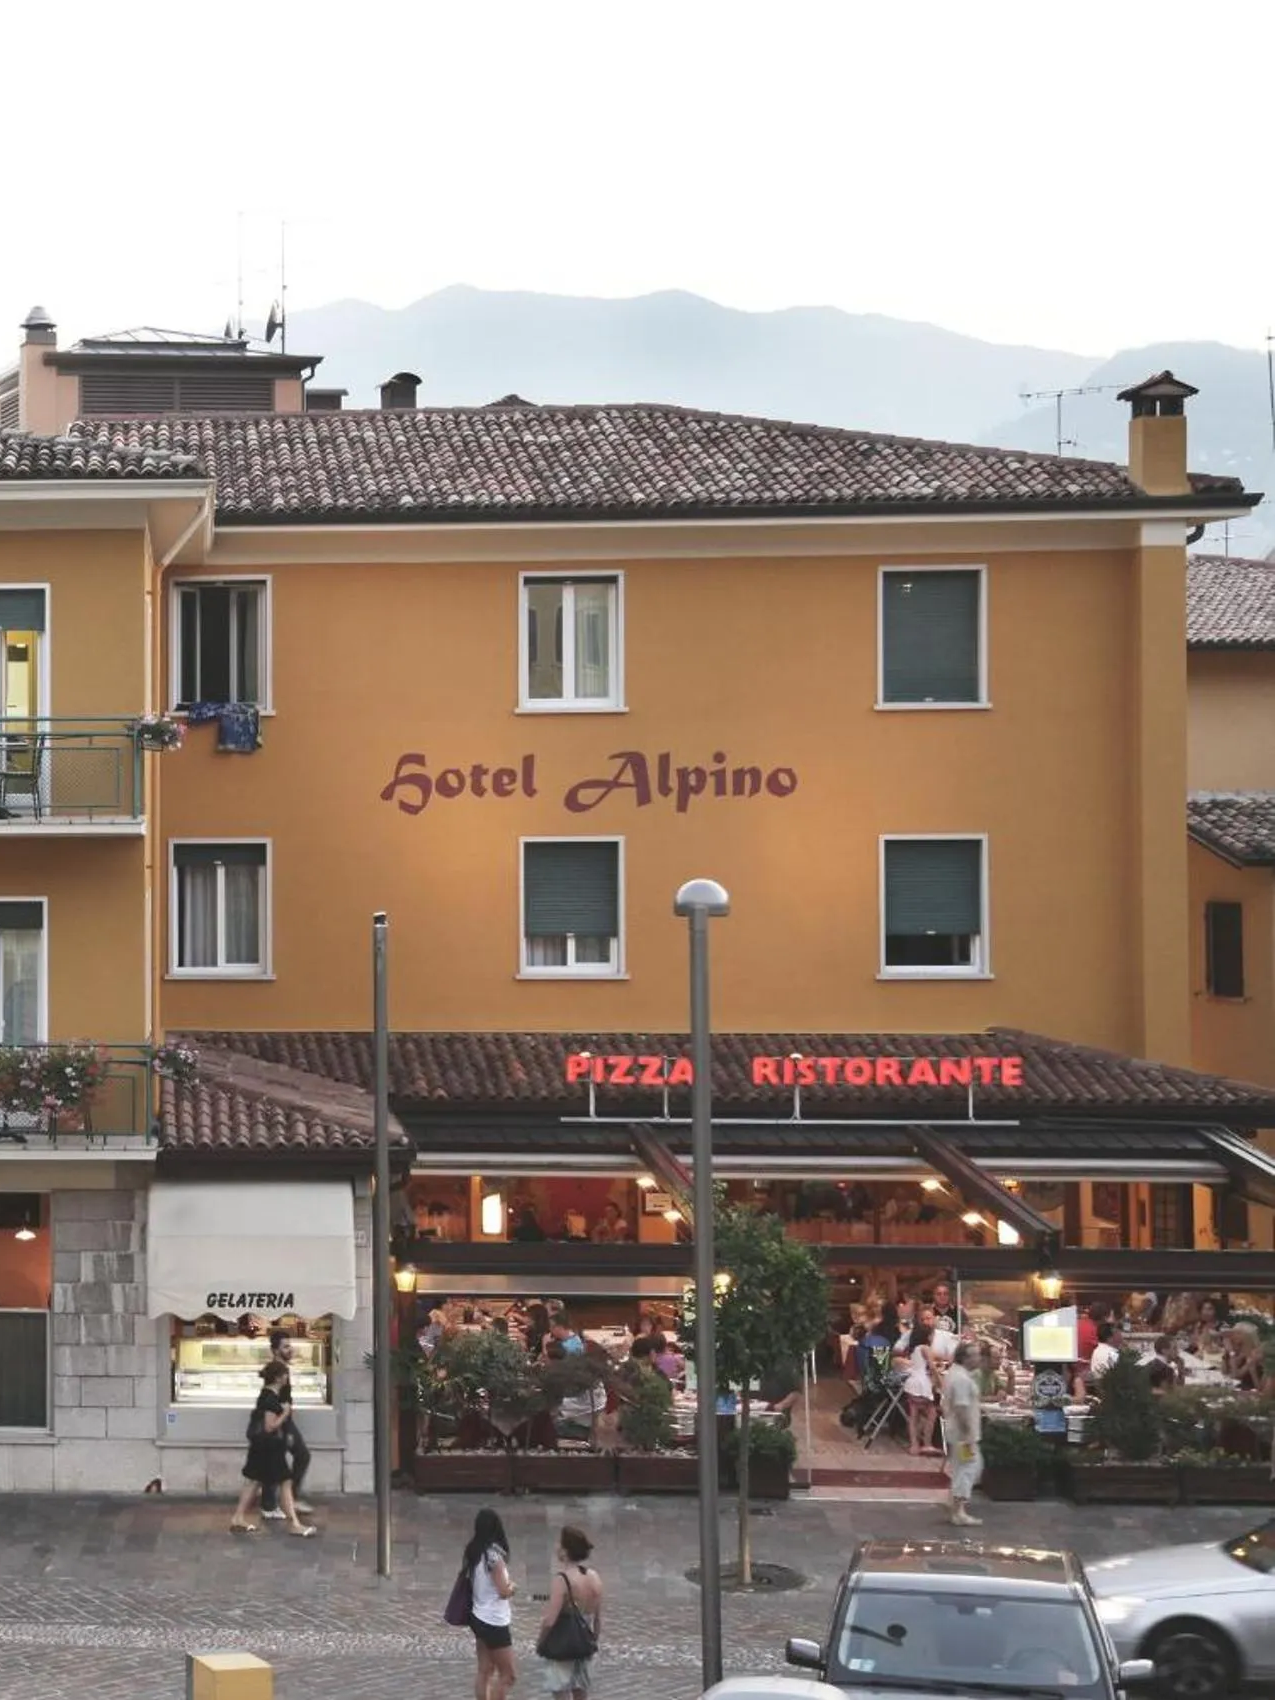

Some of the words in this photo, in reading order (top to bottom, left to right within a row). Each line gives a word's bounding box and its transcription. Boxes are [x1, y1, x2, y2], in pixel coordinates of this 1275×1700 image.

[380, 753, 539, 815] Hotel
[563, 751, 799, 813] Alpino
[565, 1055, 694, 1086] PIZZA
[751, 1056, 1024, 1087] RISTORANTE
[206, 1292, 294, 1309] GELATERIA
